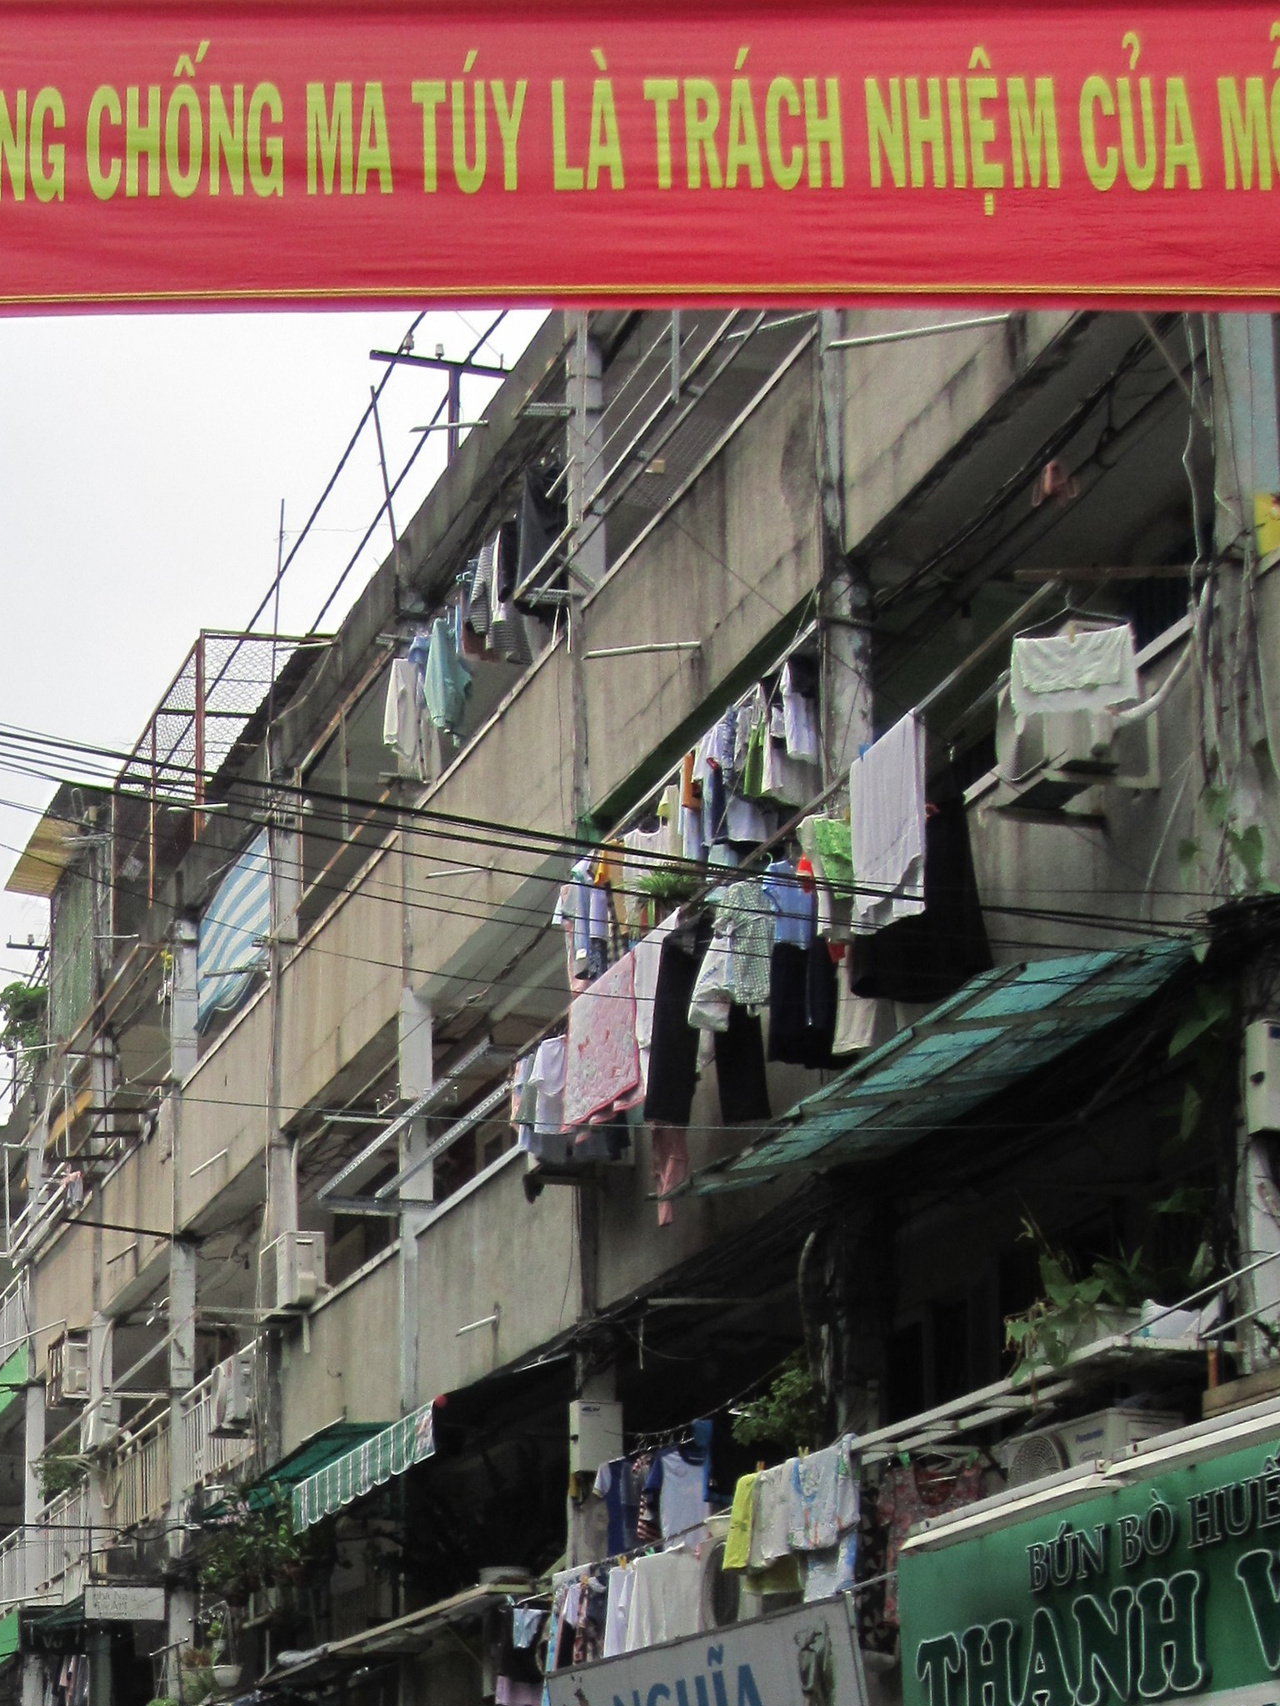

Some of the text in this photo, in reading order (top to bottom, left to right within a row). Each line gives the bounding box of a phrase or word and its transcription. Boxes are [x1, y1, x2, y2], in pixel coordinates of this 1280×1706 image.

[86, 40, 283, 200] CHỐNG
[306, 81, 393, 196] MA
[412, 50, 528, 194] TÚY
[551, 48, 624, 191] LÀ
[644, 46, 844, 191] TRÁCH
[866, 46, 1060, 216] NHIỆM
[1079, 31, 1202, 192] CỦA
[1026, 1520, 1107, 1593] BÚN
[1117, 1488, 1174, 1568] BÒ
